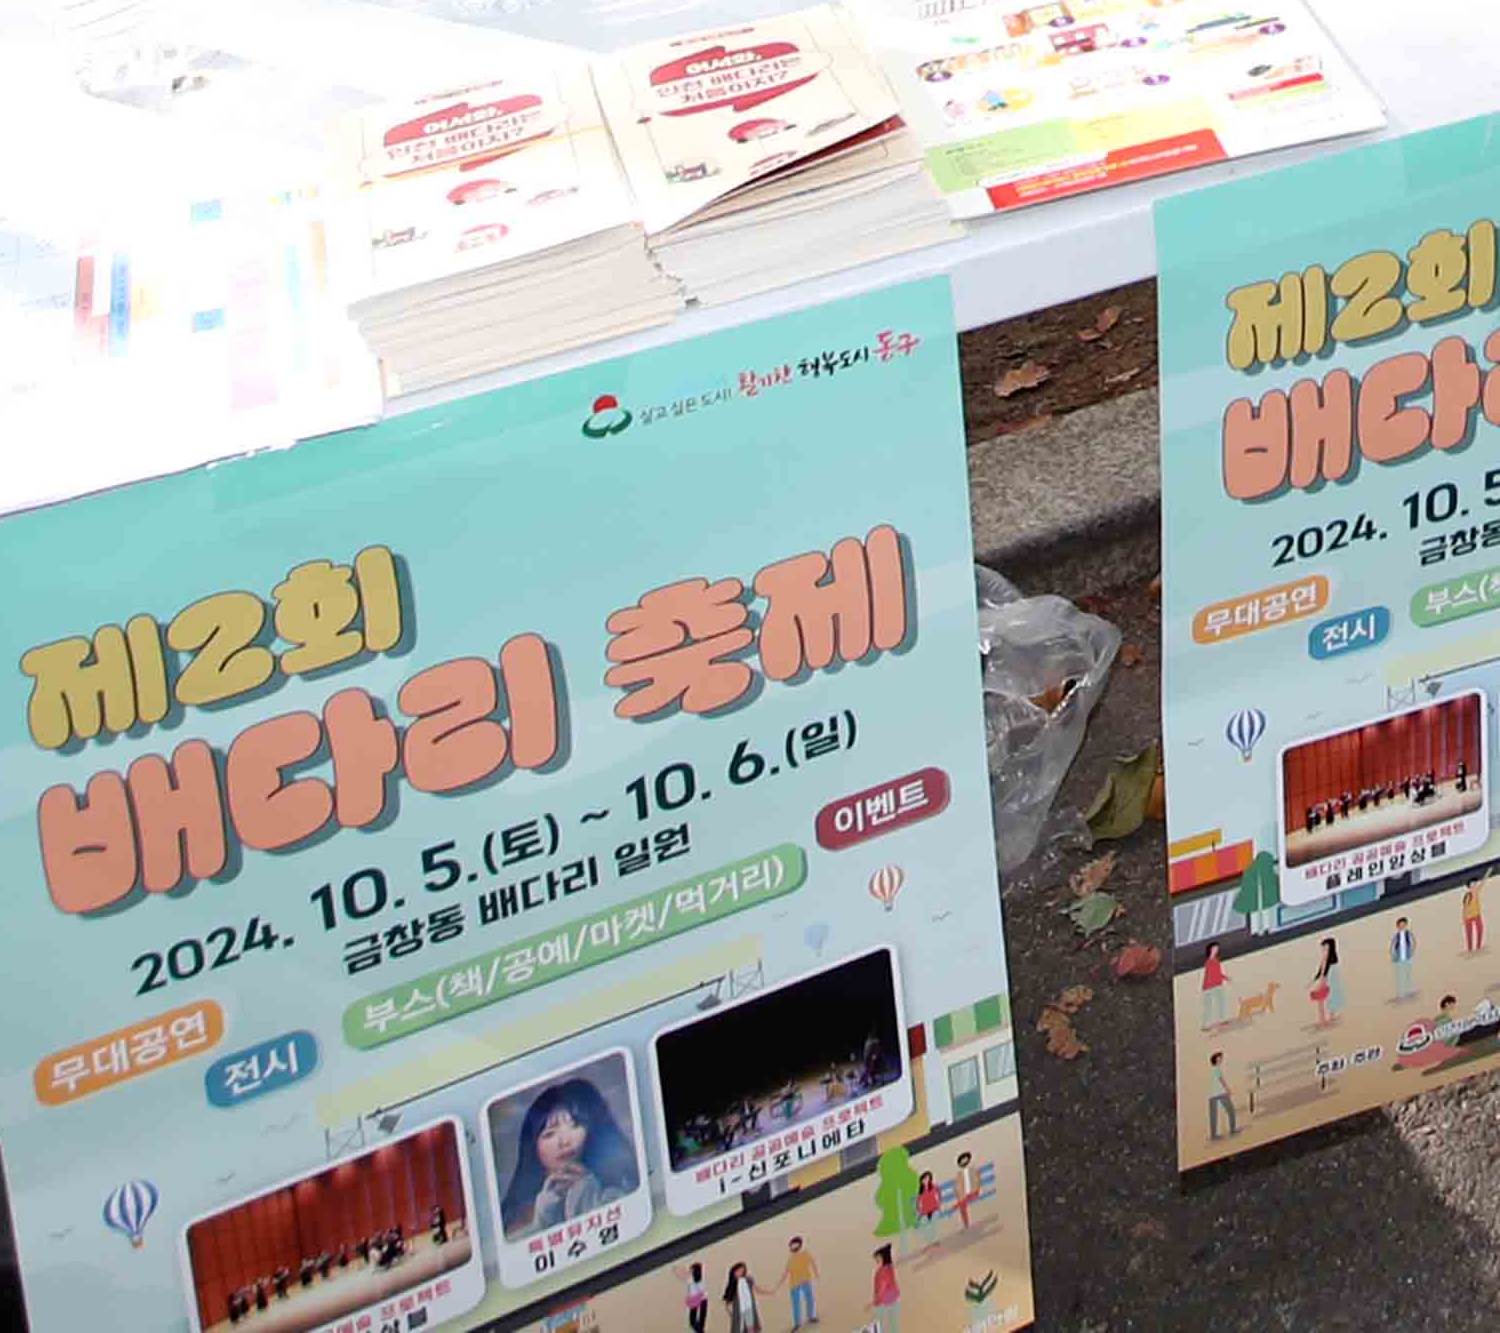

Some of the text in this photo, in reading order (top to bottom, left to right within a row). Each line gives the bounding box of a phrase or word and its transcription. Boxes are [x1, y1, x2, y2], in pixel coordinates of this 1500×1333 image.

[872, 329, 921, 364] 동구
[1271, 512, 1388, 568] 2024.
[1402, 480, 1470, 531] 10.
[21, 545, 408, 751] 제2회
[1202, 580, 1318, 640] 무대공연
[1321, 611, 1376, 653] 전시
[37, 524, 918, 917] 배다리 축제
[834, 779, 931, 838] 이벤트
[130, 914, 296, 997] 2024.
[310, 867, 406, 934] 10.
[423, 811, 562, 893] 5.(토)
[625, 761, 712, 827] 10.
[727, 706, 859, 789] 6.(일)
[342, 824, 693, 976] 금창동 배다리 일원
[363, 852, 786, 1033] 부스(책/공예/마켓/먹거리)
[50, 1013, 208, 1094] 무대공연
[223, 1046, 300, 1098] 전시
